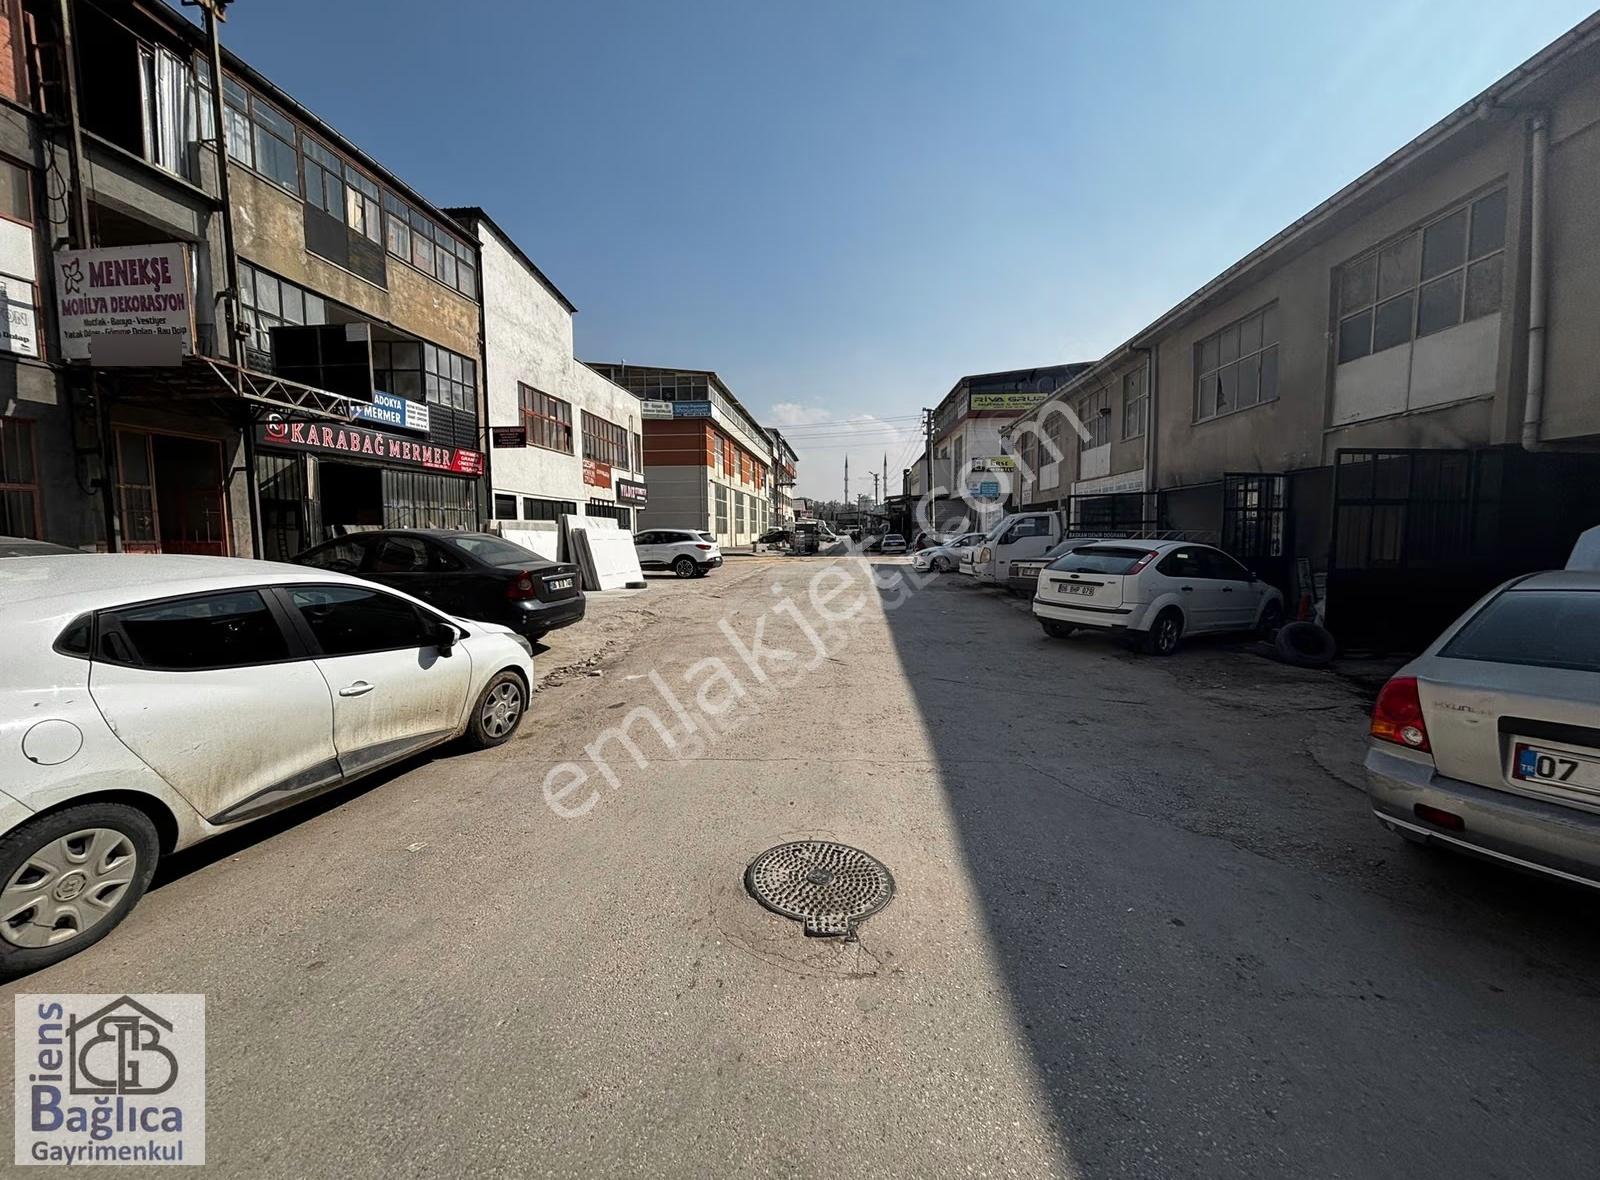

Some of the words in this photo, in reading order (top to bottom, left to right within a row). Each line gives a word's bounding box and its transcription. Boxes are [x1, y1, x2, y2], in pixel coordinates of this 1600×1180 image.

[88, 256, 172, 292] MENEKŞE
[62, 293, 108, 316] MOBİLYA
[110, 293, 186, 315] DEKORASYON
[363, 406, 401, 424] MERMER
[290, 422, 385, 456] KARABAĞ
[388, 438, 451, 467] MERMER
[1521, 763, 1535, 773] TR
[1536, 755, 1579, 782] 07
